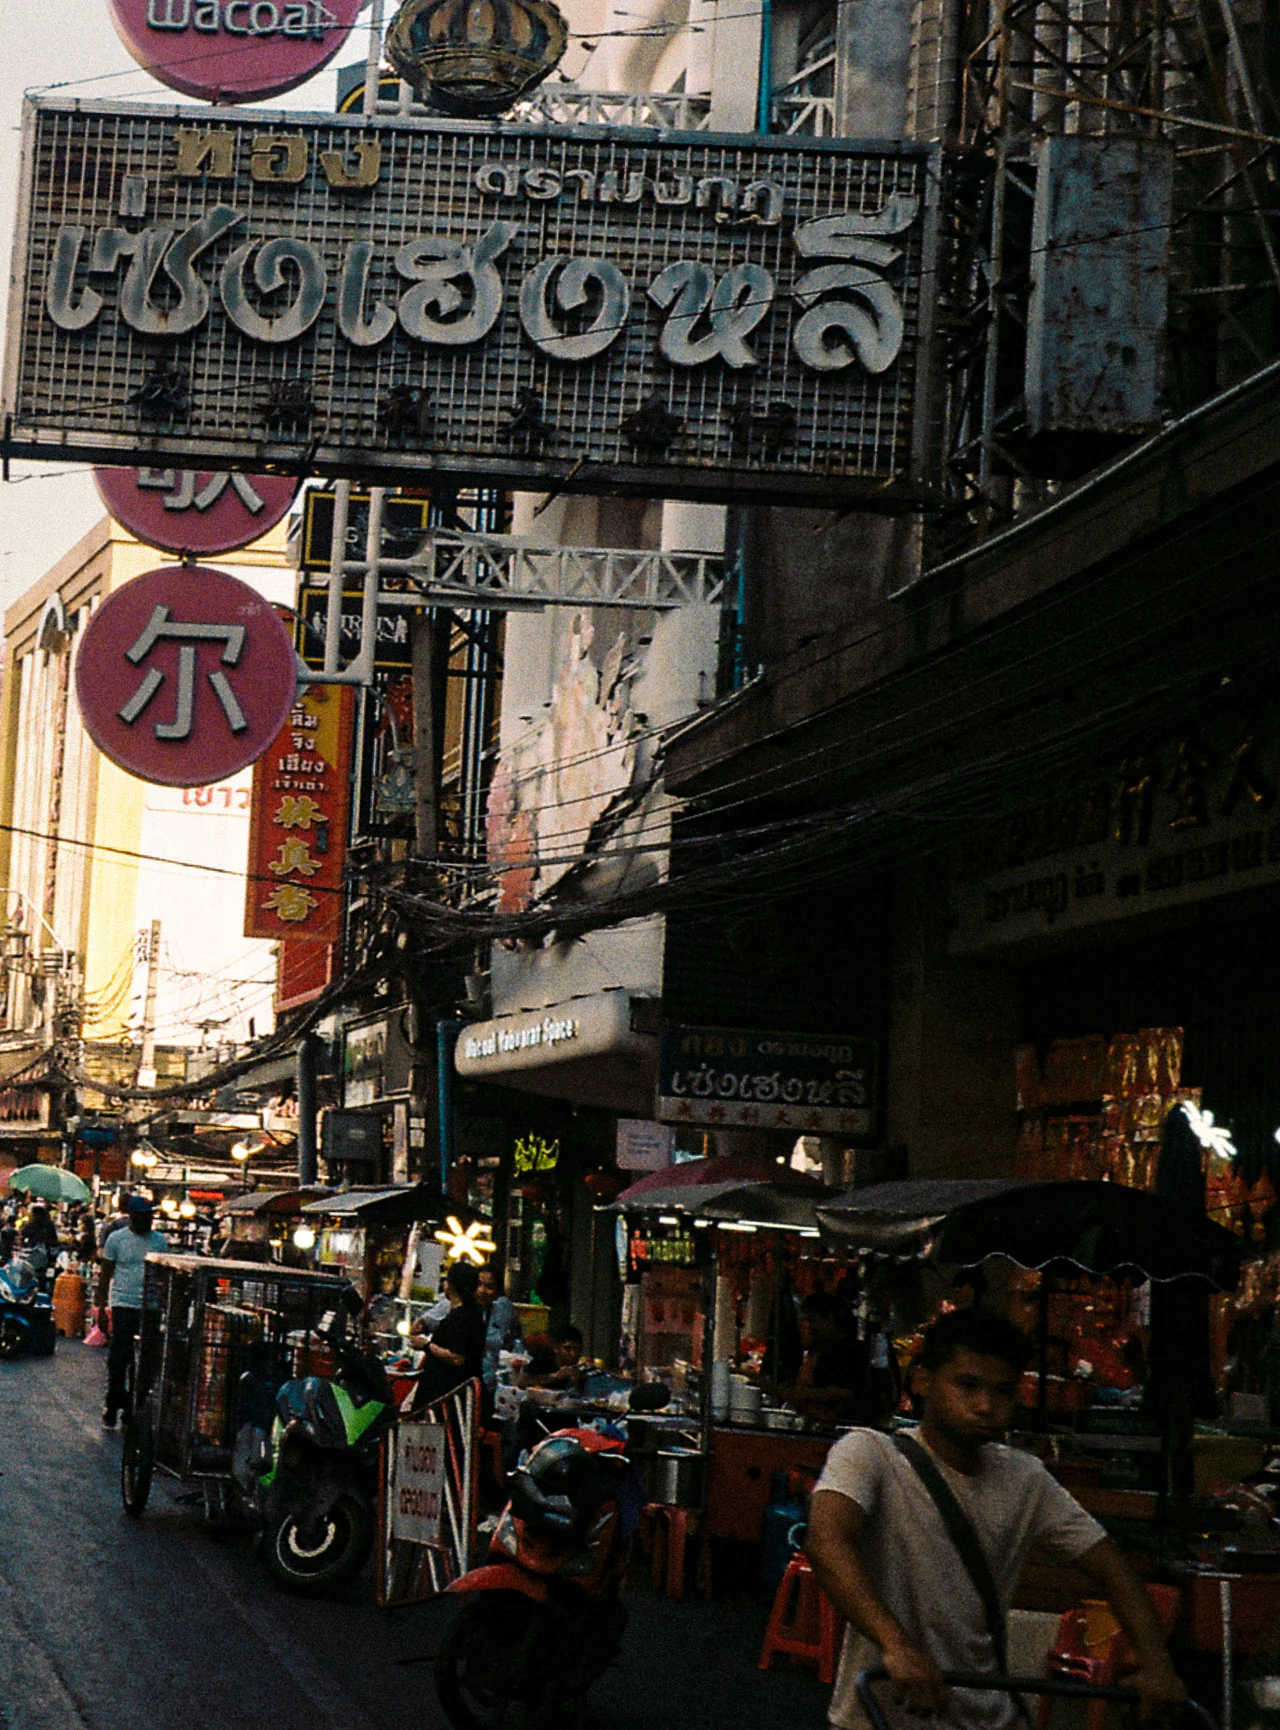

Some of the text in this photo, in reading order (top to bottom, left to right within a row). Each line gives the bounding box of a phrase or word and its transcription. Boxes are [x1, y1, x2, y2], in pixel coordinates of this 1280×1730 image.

[174, 126, 382, 190] ทอง
[46, 175, 917, 375] เซ่งเฮงหลี
[670, 1062, 867, 1104] เซ่งเฮงหลี
